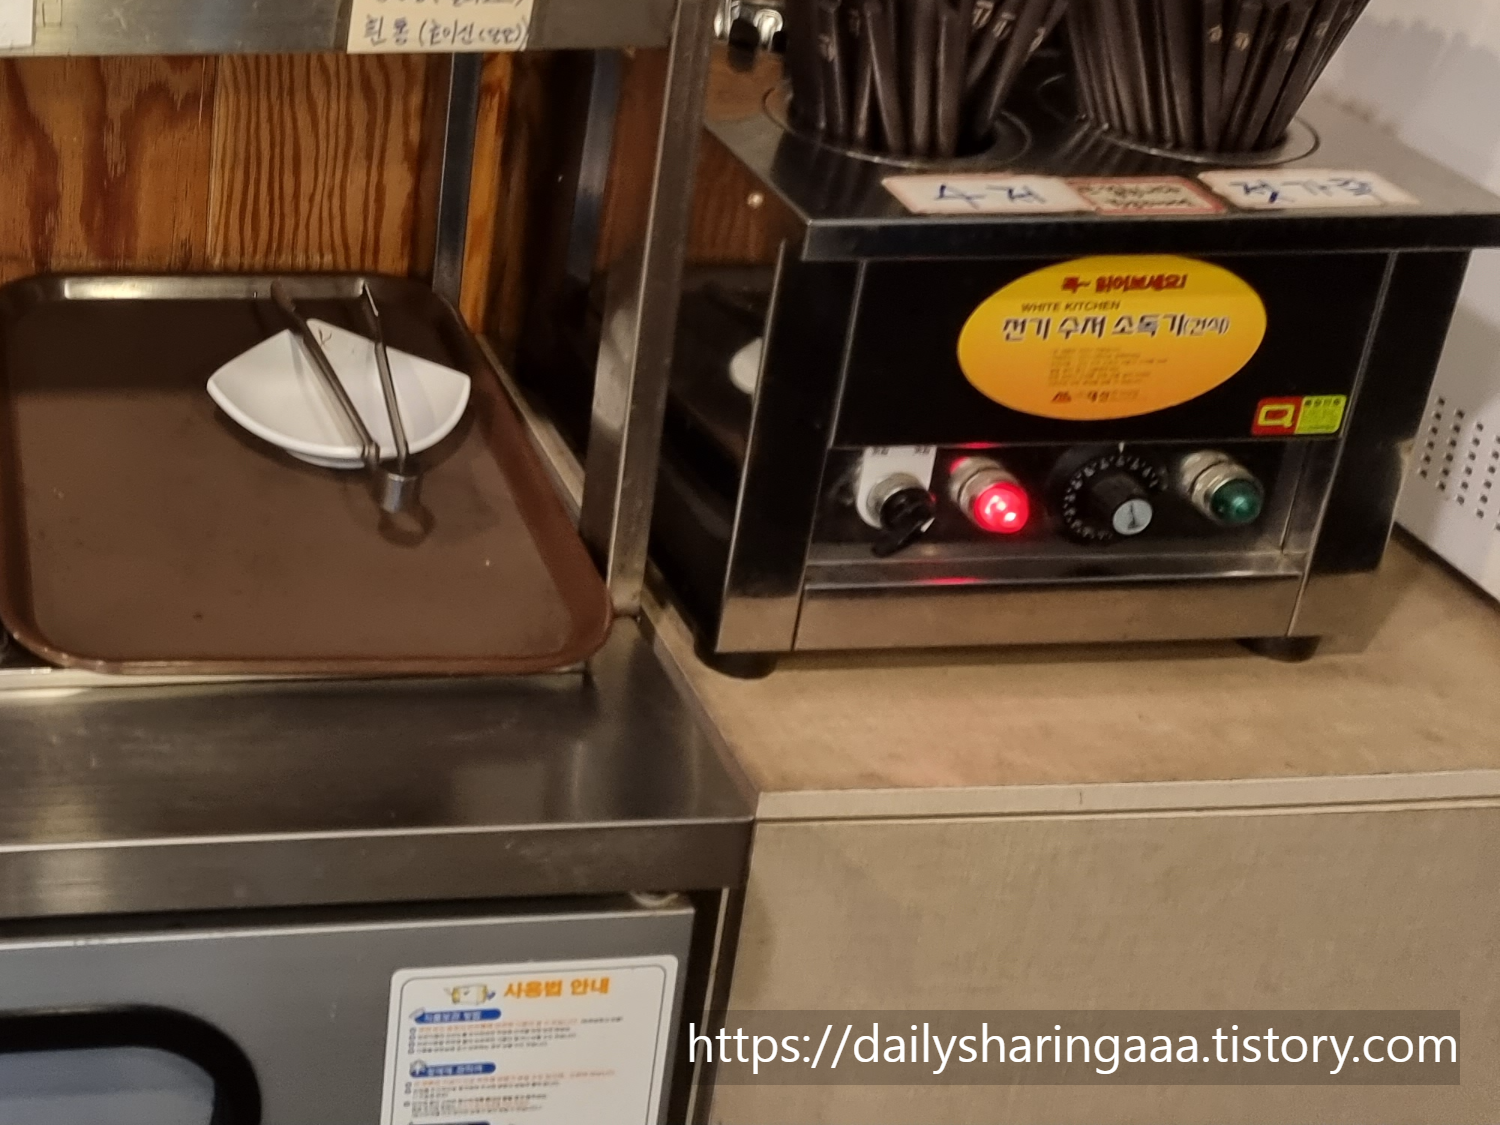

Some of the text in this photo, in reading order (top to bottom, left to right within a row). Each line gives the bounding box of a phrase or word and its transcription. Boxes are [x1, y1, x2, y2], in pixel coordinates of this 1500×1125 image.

[1021, 300, 1121, 312] WHITE KITCHEN
[1002, 316, 1051, 341] 전기
[1058, 315, 1107, 339] 수저
[503, 977, 610, 999] 사용법 안내
